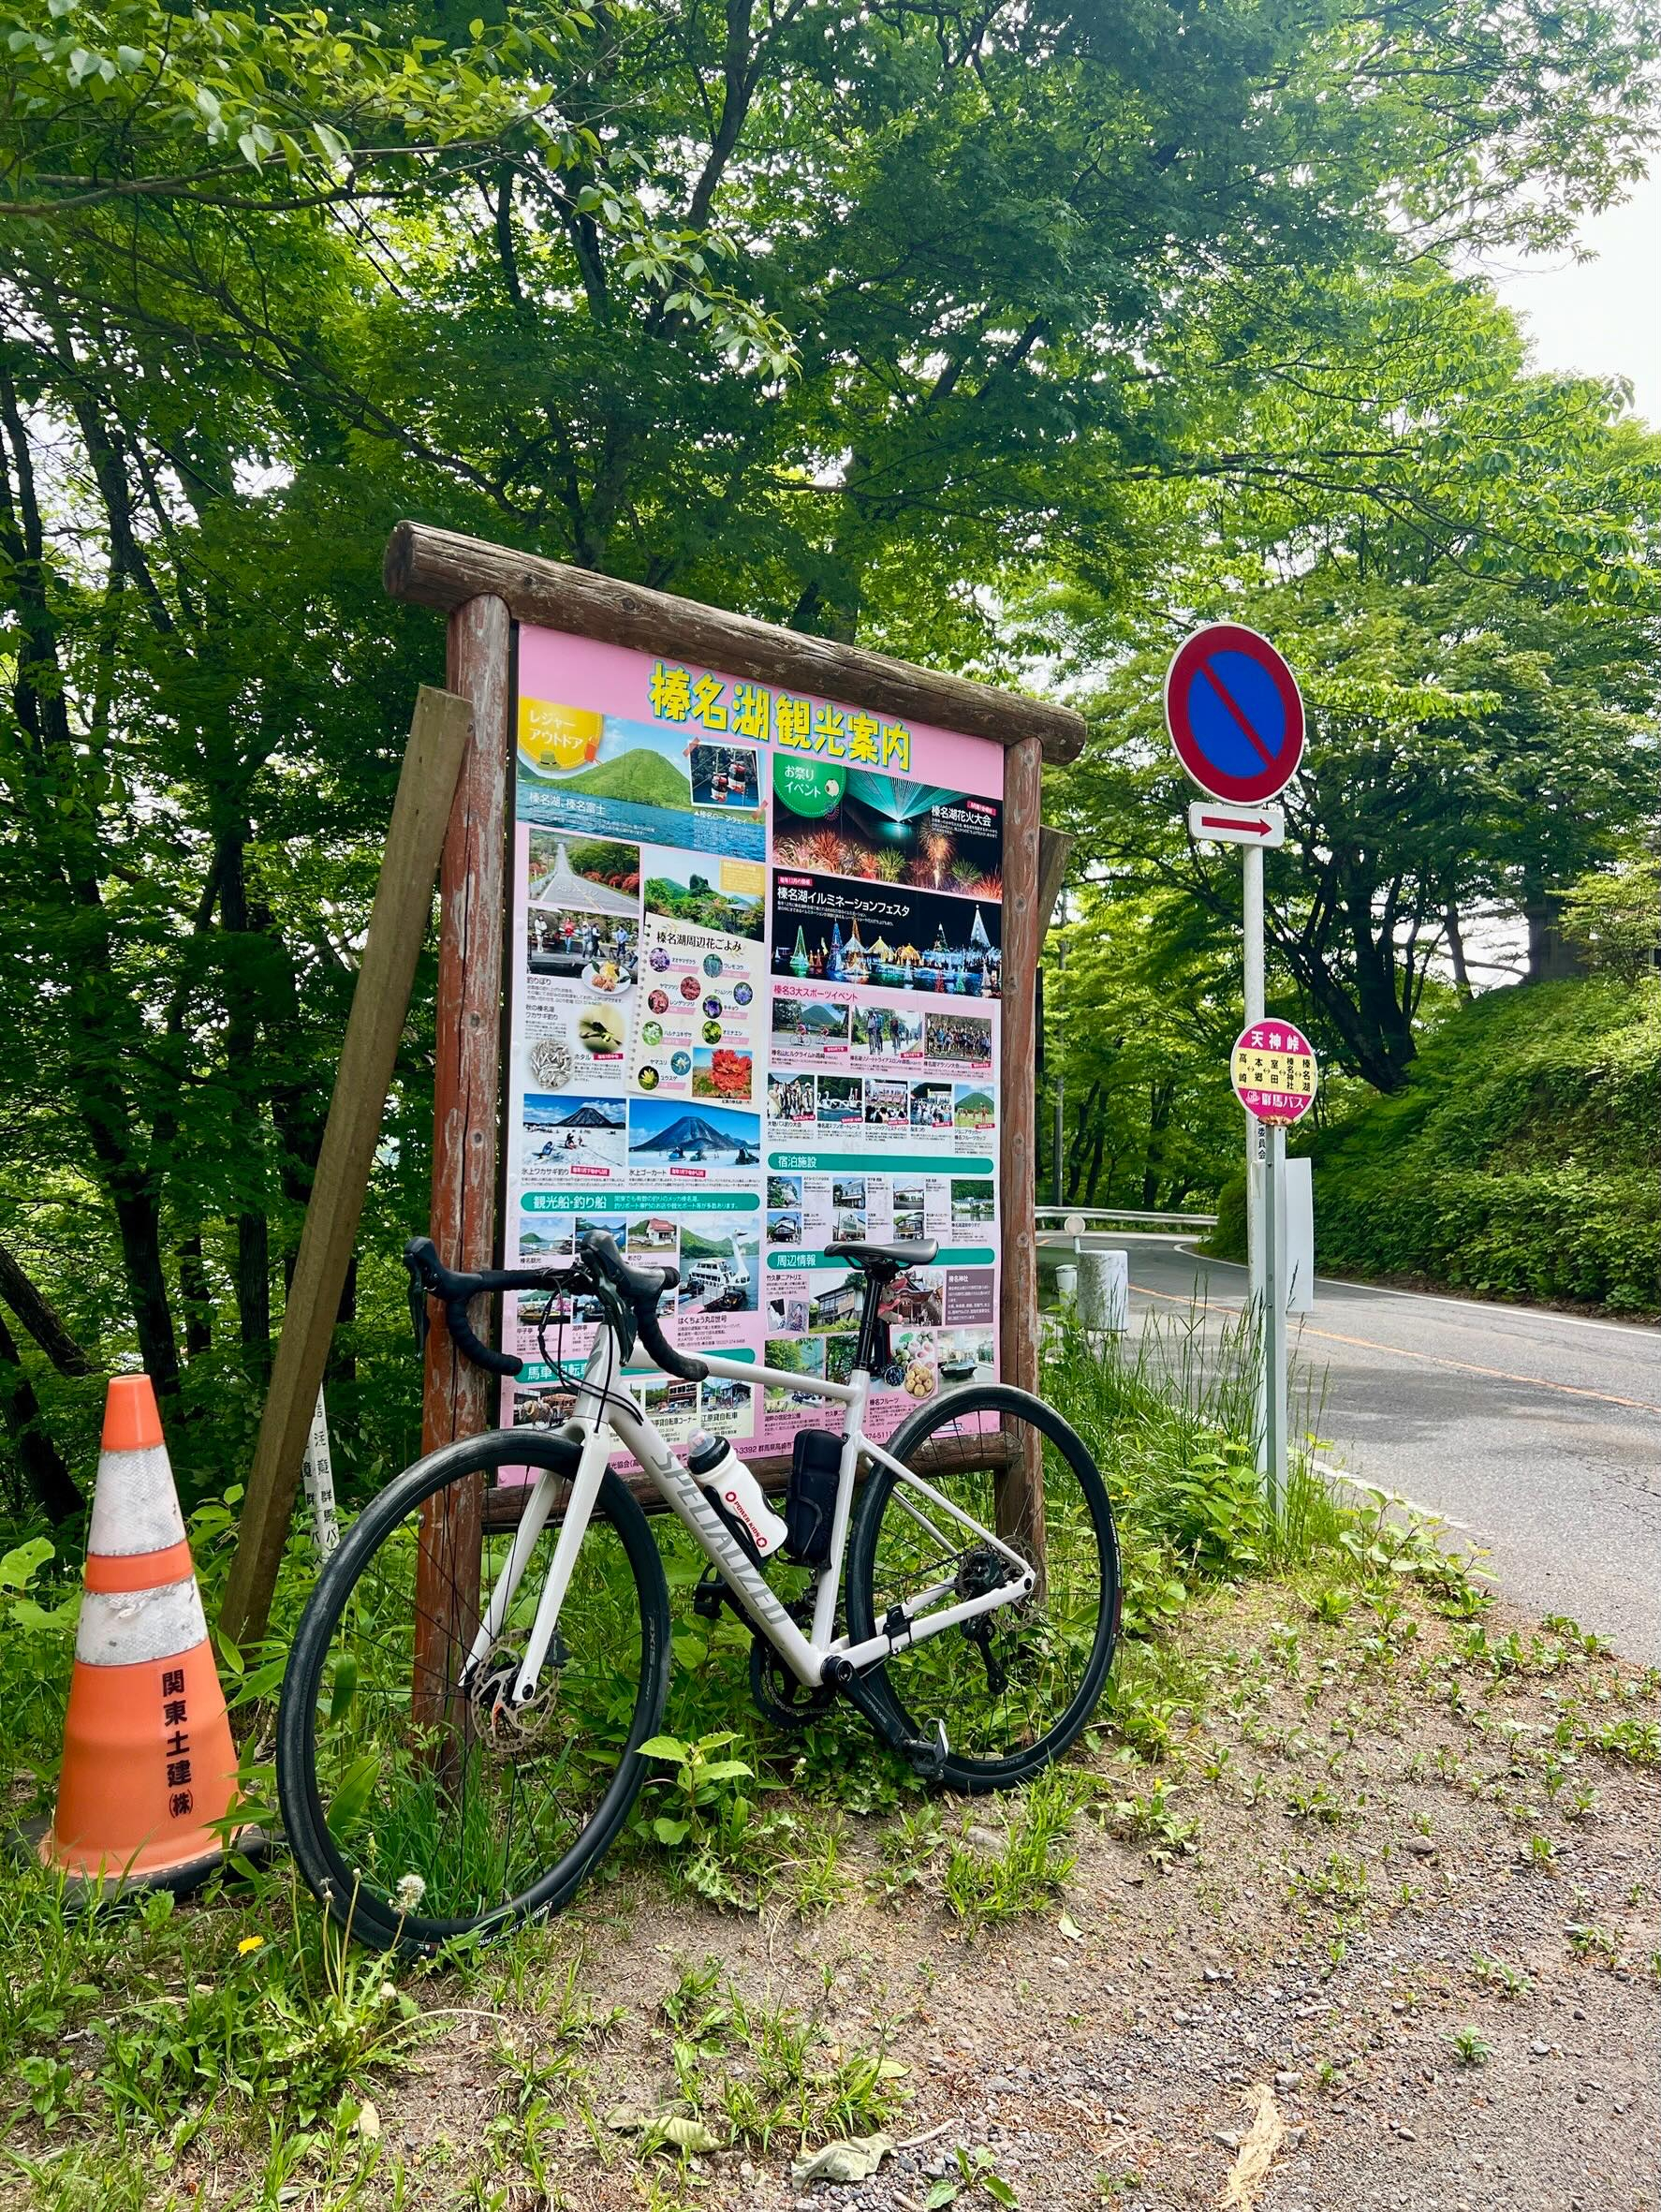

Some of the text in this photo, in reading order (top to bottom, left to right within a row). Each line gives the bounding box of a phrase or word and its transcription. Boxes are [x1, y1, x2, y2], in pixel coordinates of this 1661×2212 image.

[529, 709, 577, 730] レジャー
[648, 659, 912, 773] 榛名湖観光案内
[528, 727, 583, 749] アウトドア
[784, 765, 815, 781] お祭り
[784, 781, 822, 799] イベント
[931, 804, 992, 828] 榛名湖花火大会
[776, 886, 911, 918] 榛名湖イルミネーションフェスタ
[656, 931, 742, 952] 榛名湖周辺花ごよみ
[773, 984, 859, 1002] 榛名3大スポーツイベント
[1251, 1030, 1300, 1051] 天神峠
[1239, 1053, 1247, 1084] 高崎
[1271, 1059, 1279, 1084] 室田
[1261, 1093, 1304, 1109] 群馬バス
[1257, 1124, 1266, 1159] 委員会
[521, 1168, 569, 1176] 氷上ワカサギ釣り
[778, 1155, 817, 1170] 宿泊施設
[533, 1195, 607, 1210] 観光船・釣り船
[776, 1254, 816, 1268] 周辺情報
[766, 1274, 802, 1282] 竹久夢二アトリエ
[869, 1397, 899, 1406] 榛名フルーツ
[734, 1500, 751, 1523] POWER
[651, 1451, 789, 1626] SPECIALIZED
